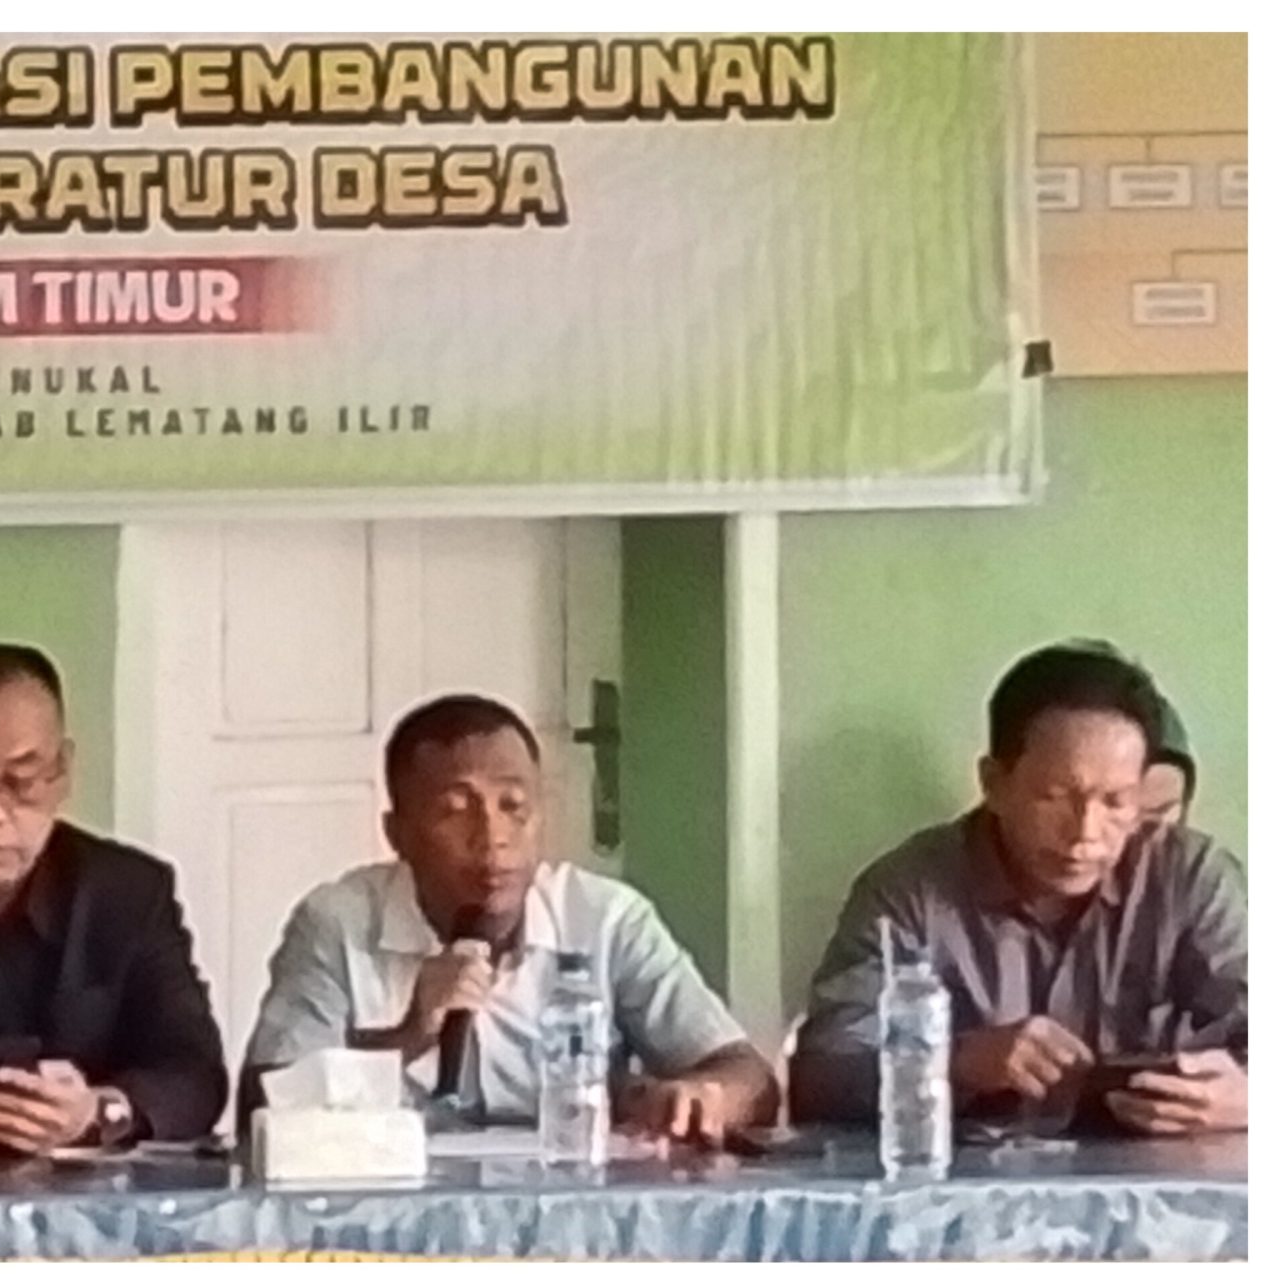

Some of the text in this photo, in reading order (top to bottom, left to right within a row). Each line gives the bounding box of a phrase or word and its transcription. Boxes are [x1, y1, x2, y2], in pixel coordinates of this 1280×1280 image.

[111, 38, 836, 127] PEMBANGUNAN
[314, 144, 569, 228] DESA
[33, 270, 240, 324] TIMUR
[66, 406, 309, 437] LEMATANG
[338, 404, 432, 433] ILIR
